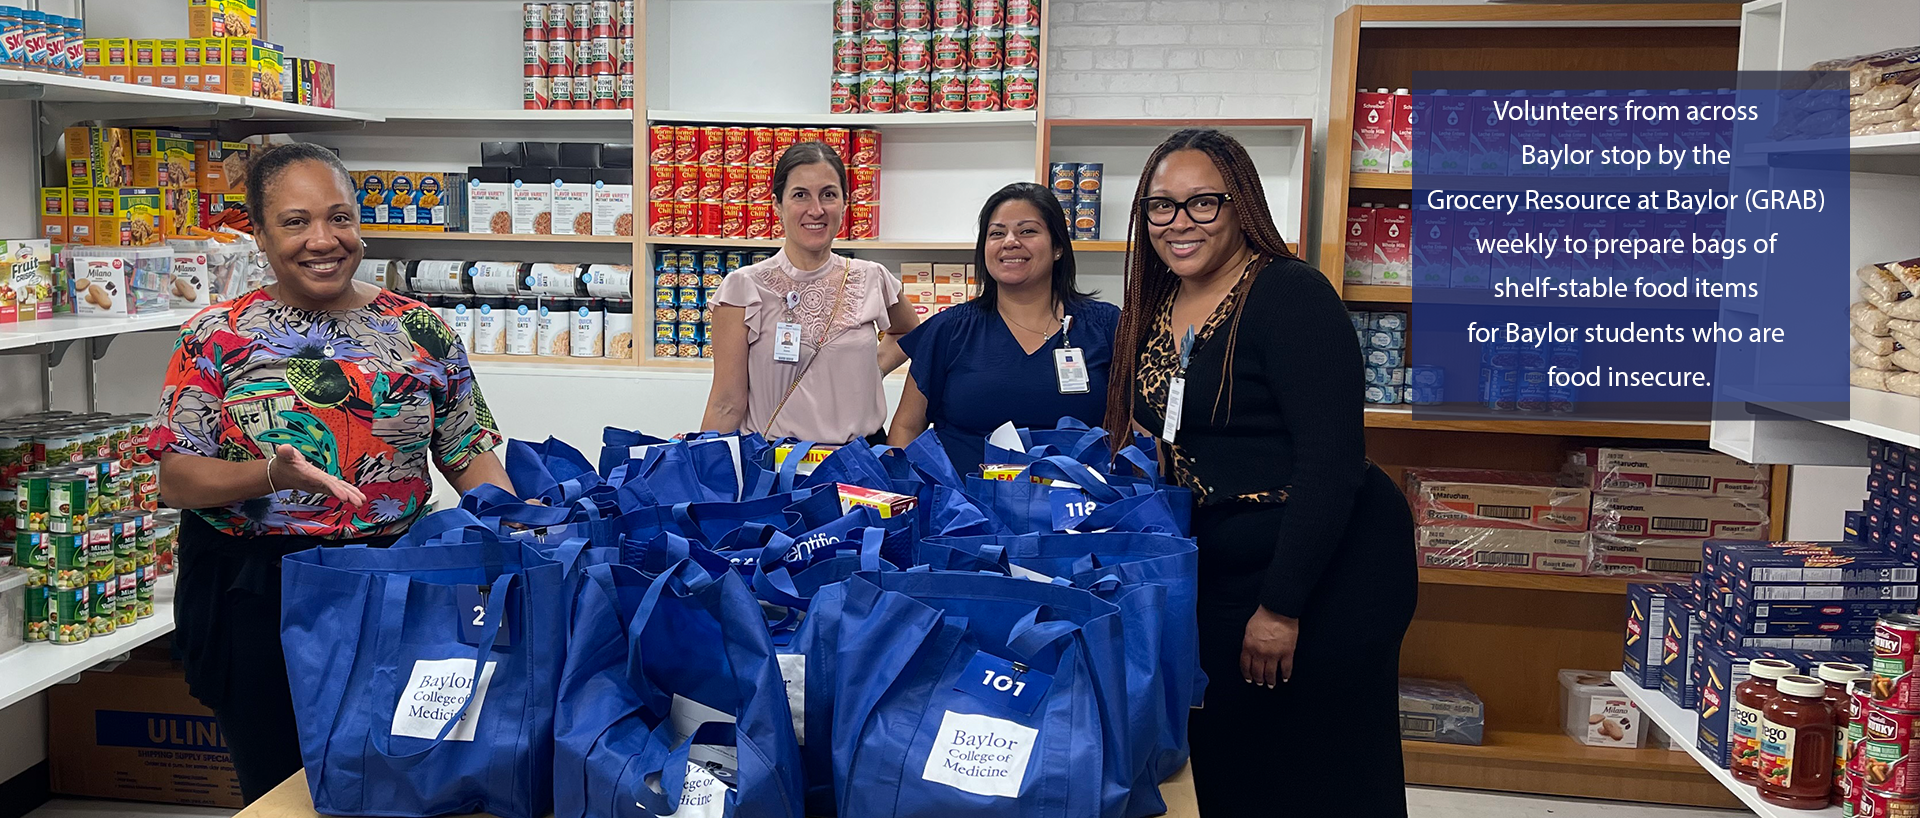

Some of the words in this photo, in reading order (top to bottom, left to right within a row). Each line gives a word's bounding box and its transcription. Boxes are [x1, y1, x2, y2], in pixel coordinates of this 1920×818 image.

[12, 257, 39, 279] Fruit
[16, 270, 36, 282] CRISPS
[86, 268, 112, 278] Milano
[173, 264, 196, 273] Milano
[1066, 501, 1097, 517] 118
[418, 672, 474, 690] Baylor
[982, 670, 1026, 697] 101
[413, 690, 456, 706] College
[1704, 689, 1720, 705] Barilla
[408, 705, 467, 720] Medicie
[1602, 706, 1628, 715] Milano
[951, 729, 1018, 751] Baylor
[174, 752, 200, 760] SUPPLY
[948, 748, 995, 764] College
[996, 754, 1013, 764] of
[943, 758, 1008, 778] Medicine
[680, 794, 712, 806] dicine
